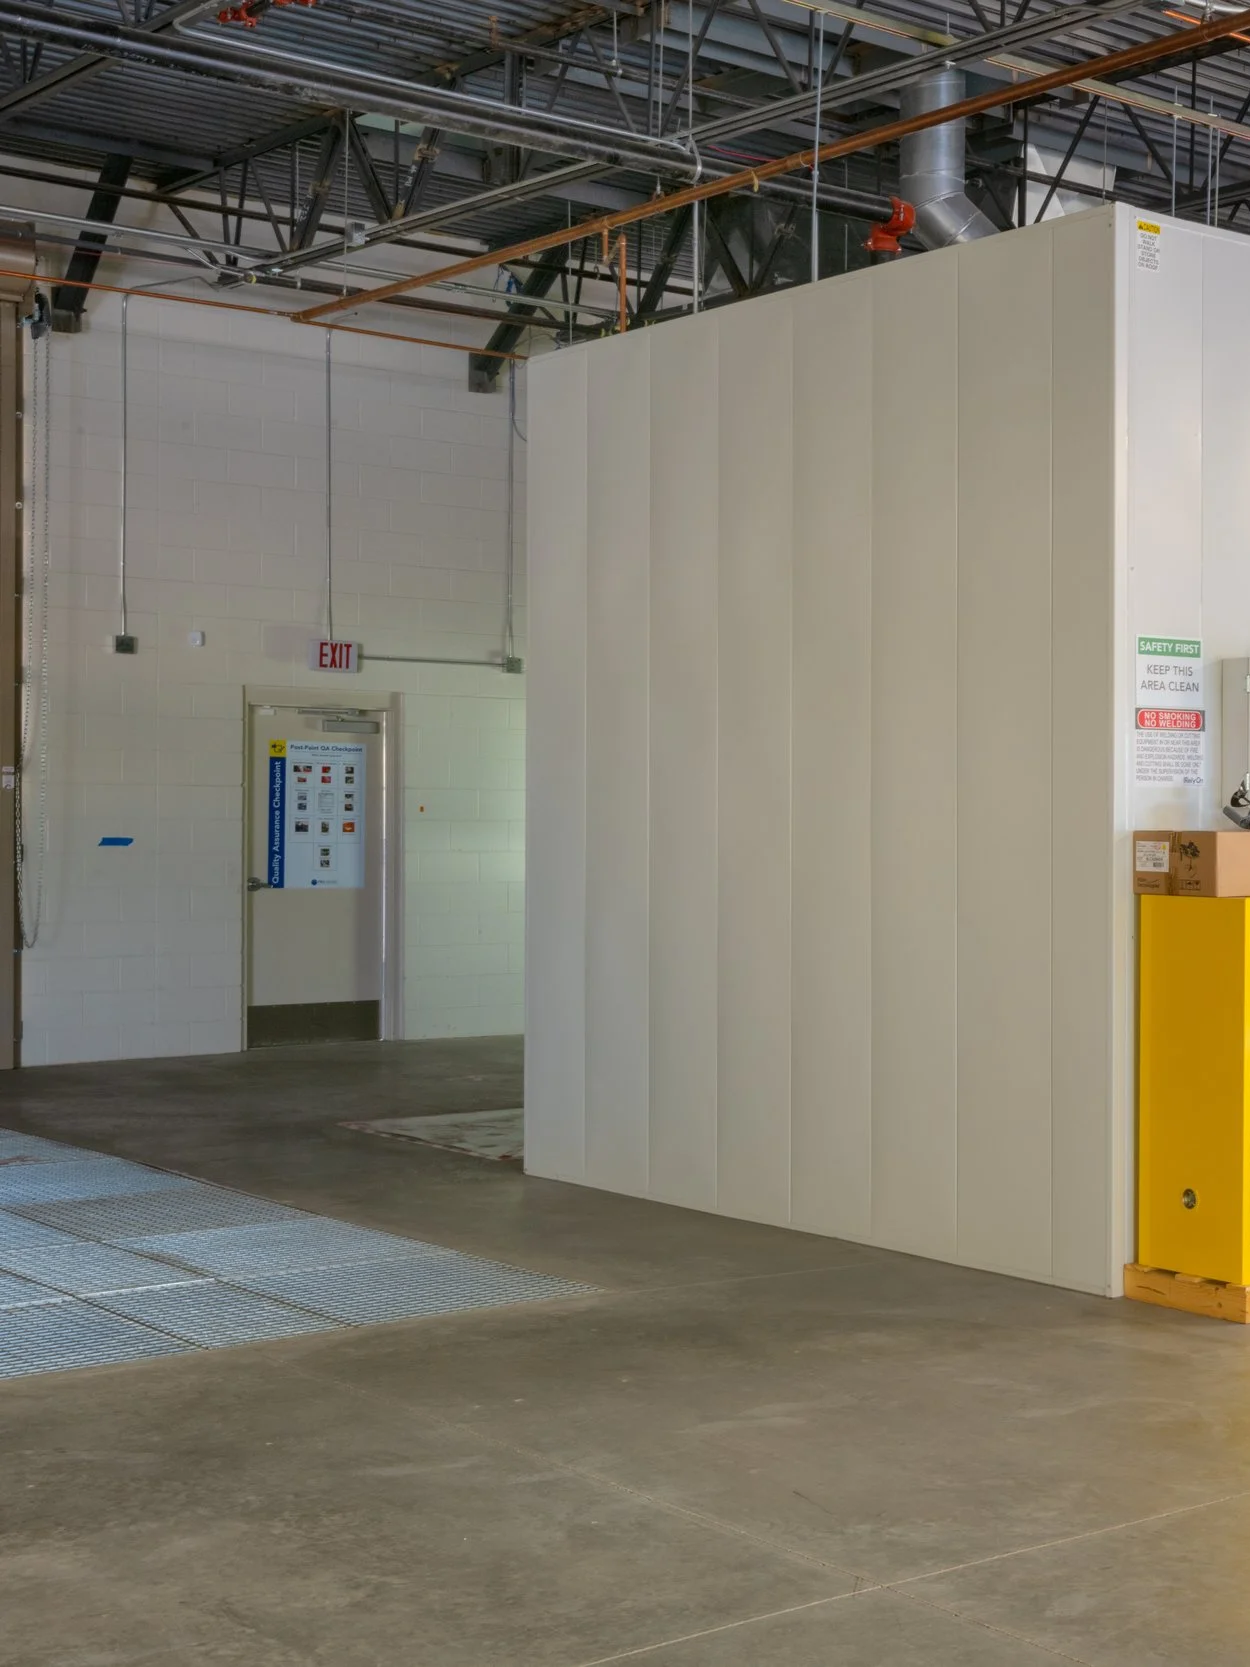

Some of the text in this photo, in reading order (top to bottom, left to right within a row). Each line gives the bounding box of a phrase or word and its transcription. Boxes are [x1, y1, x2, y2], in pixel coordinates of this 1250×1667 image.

[1139, 640, 1200, 654] SAFETY FIRST
[319, 641, 353, 670] EXIT
[1146, 664, 1194, 677] KEEP THIS
[1140, 679, 1200, 693] AREA CLEAN
[1144, 711, 1197, 721] NO SMOKING
[1144, 719, 1197, 729] NO WELDING
[290, 743, 363, 754] Post-Paint QA Checkpoint
[271, 760, 284, 885] Quality Assurance Checkpoint
